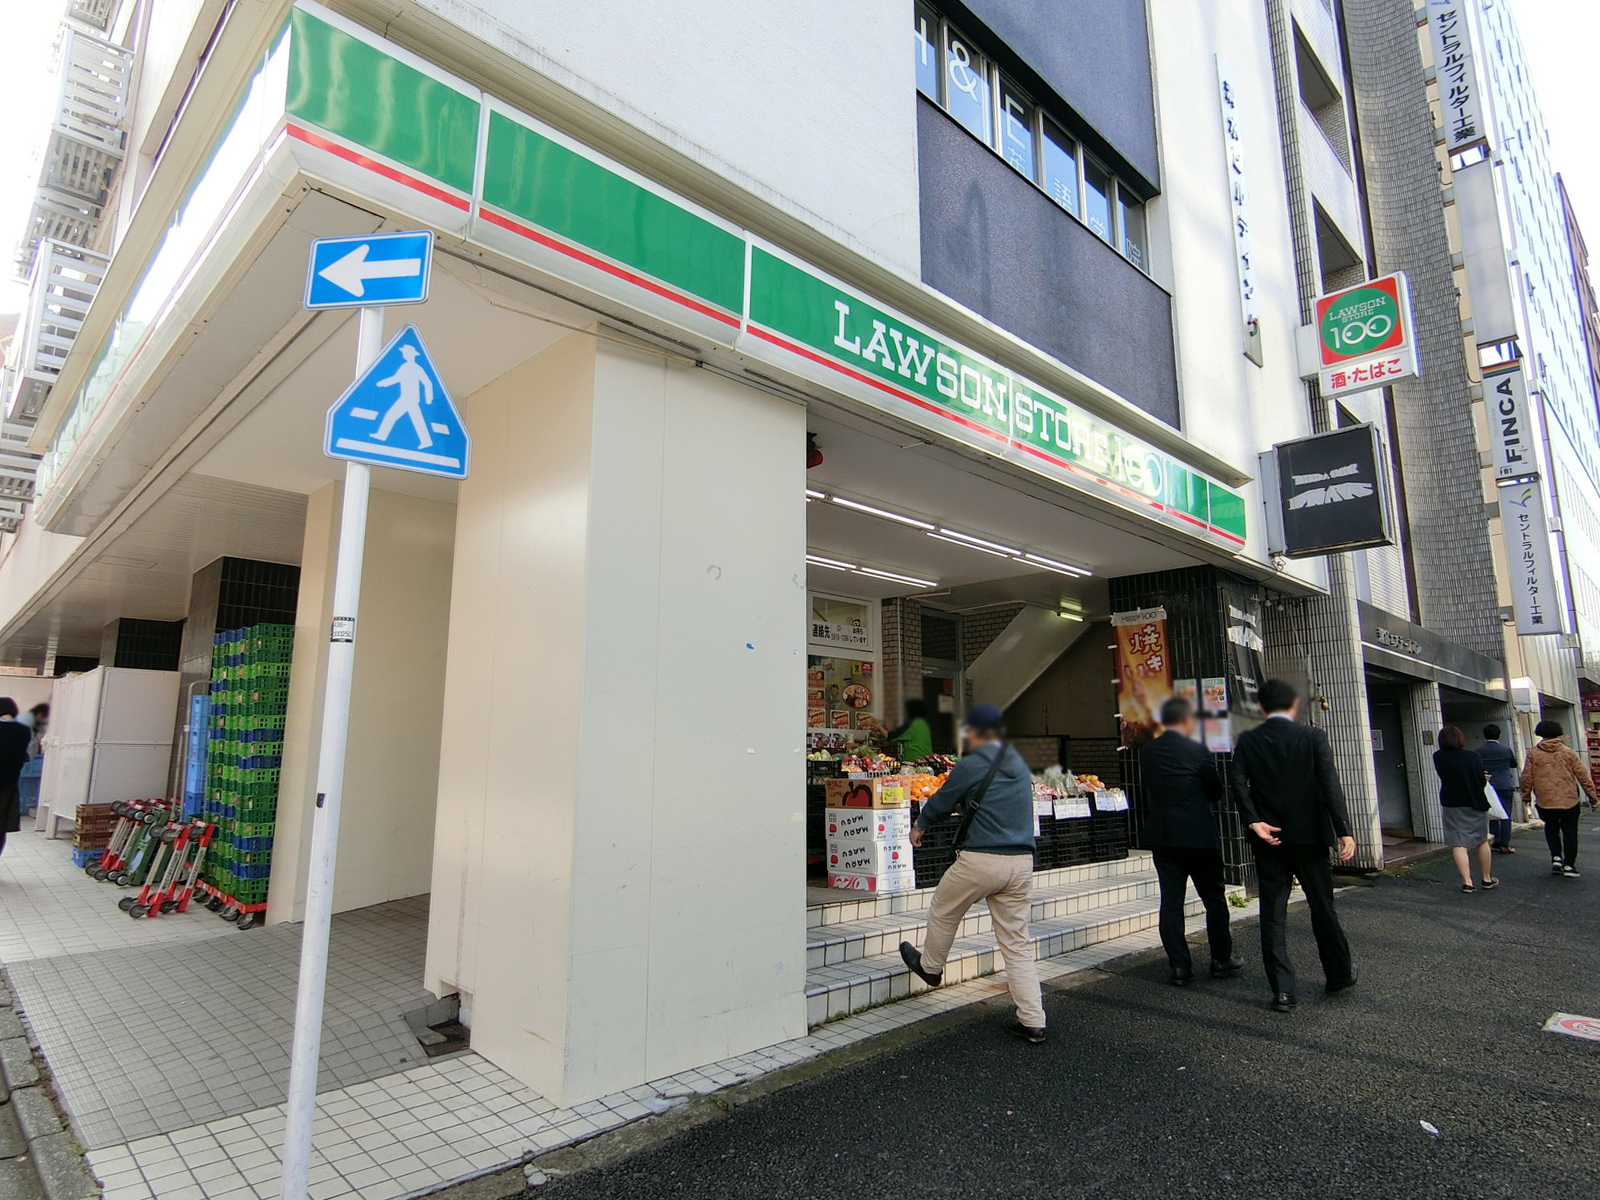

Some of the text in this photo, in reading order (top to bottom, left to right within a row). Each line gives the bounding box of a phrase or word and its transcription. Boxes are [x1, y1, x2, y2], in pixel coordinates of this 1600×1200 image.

[1436, 9, 1476, 143] セントラルフィルター工業
[1329, 296, 1387, 321] LAWSON
[1341, 308, 1375, 323] STORE
[1330, 314, 1392, 349] 100
[834, 300, 1007, 422] LAWSON
[1015, 391, 1110, 469] STORE
[1496, 377, 1523, 463] FINCA
[1517, 513, 1544, 626] セントラルフィルター工業
[812, 623, 831, 639] 連絡先
[1129, 623, 1163, 672] 焼き
[843, 825, 869, 837] MARU
[845, 858, 871, 869] MARU
